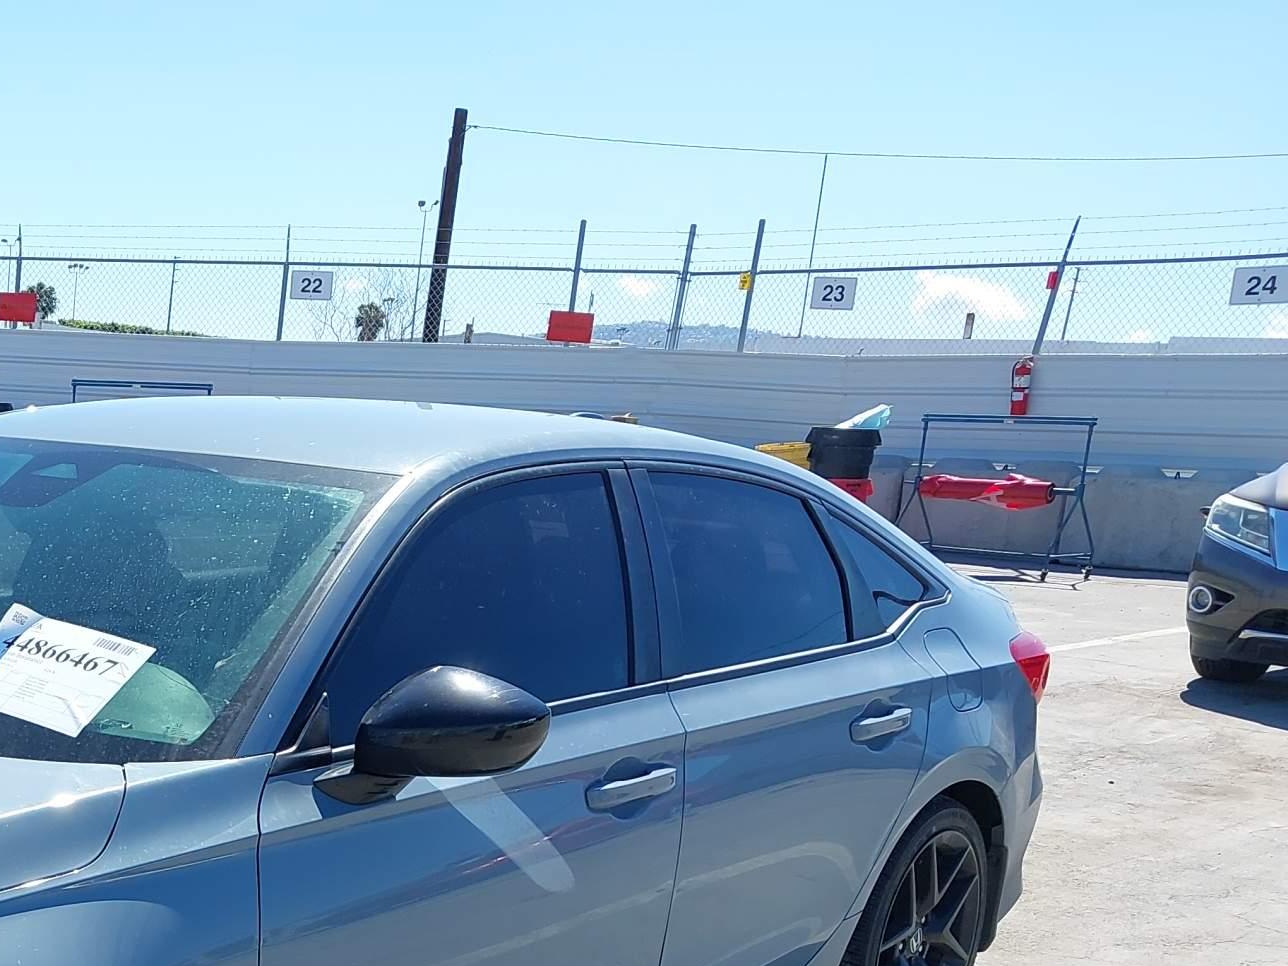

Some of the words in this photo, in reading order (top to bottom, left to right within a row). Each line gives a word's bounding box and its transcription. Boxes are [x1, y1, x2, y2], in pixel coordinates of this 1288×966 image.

[300, 277, 323, 293] 22
[821, 284, 845, 302] 23
[1244, 275, 1278, 296] 24
[2, 633, 120, 676] 44866467
